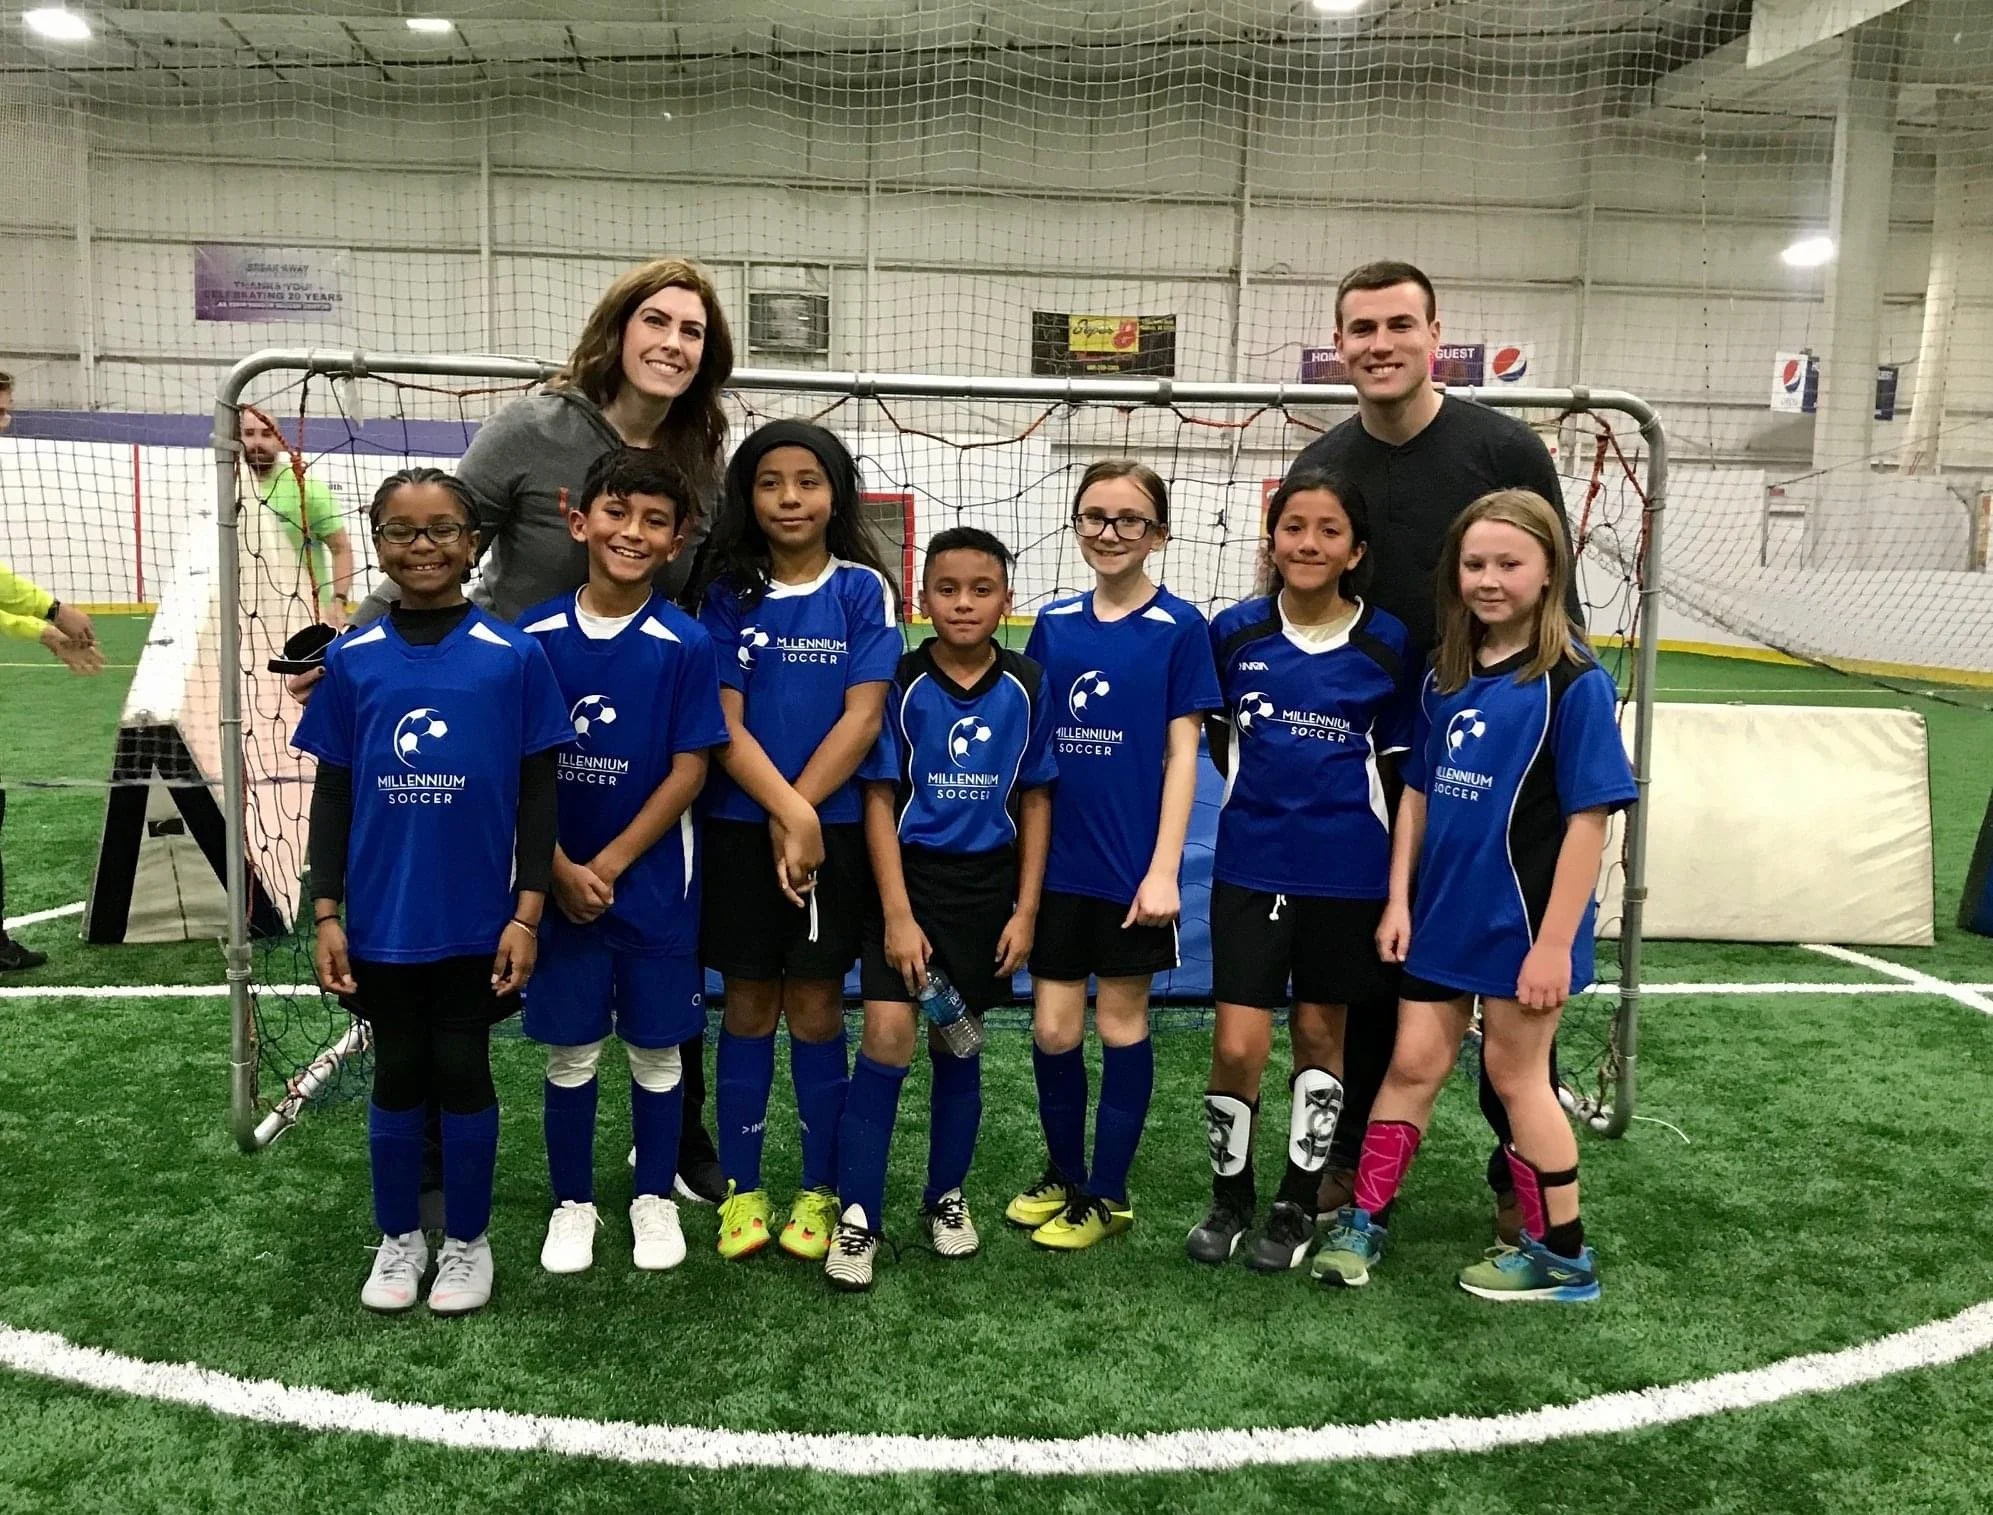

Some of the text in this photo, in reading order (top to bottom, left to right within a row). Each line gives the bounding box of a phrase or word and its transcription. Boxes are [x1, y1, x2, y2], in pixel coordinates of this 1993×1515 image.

[287, 292, 301, 301] 20
[304, 292, 343, 302] YEARS
[1311, 351, 1343, 363] HOM
[1434, 347, 1475, 360] GUEST
[1291, 726, 1347, 744] SOCCER
[1059, 743, 1112, 756] SOCCER
[558, 752, 629, 772] ILLENNIUM
[378, 773, 465, 788] MILLENNIUM
[557, 769, 617, 786] SOCCER
[388, 793, 453, 804] SOCCER
[1434, 782, 1479, 802] SOCCER
